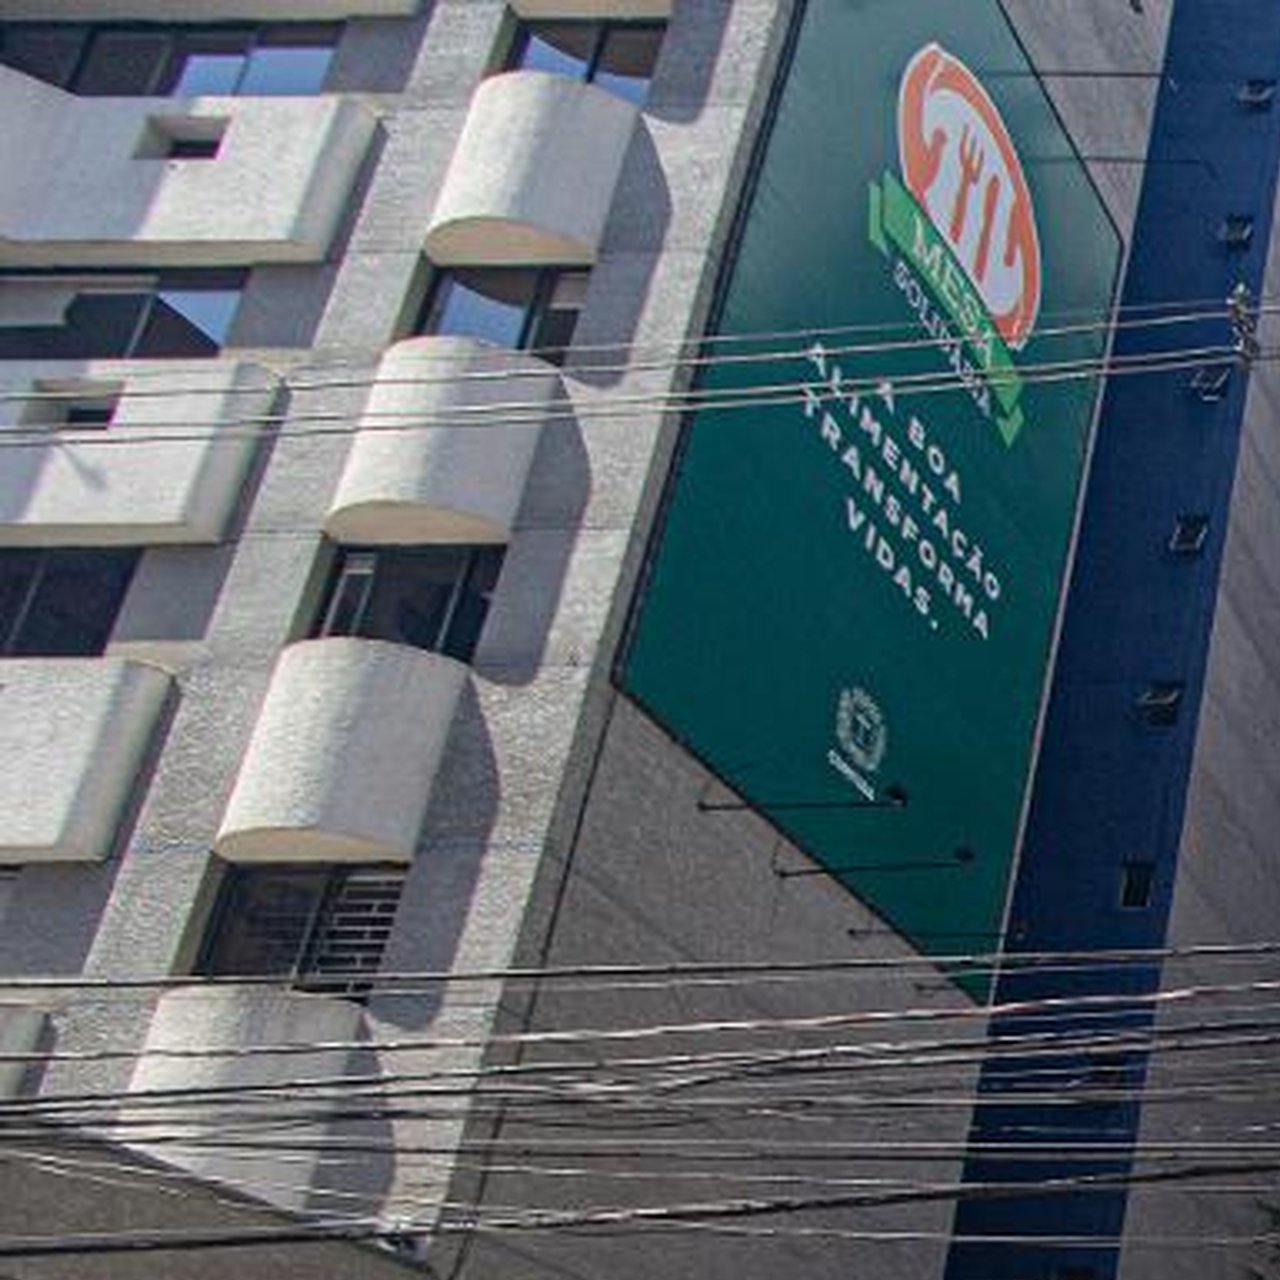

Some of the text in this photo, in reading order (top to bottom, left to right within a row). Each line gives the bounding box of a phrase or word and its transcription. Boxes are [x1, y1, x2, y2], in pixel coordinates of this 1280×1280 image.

[802, 387, 988, 639] TRANSFORMA
[809, 342, 1000, 599] ALIMENTAÇÃO
[908, 416, 961, 503] BOA
[847, 497, 939, 630] VIDAS.
